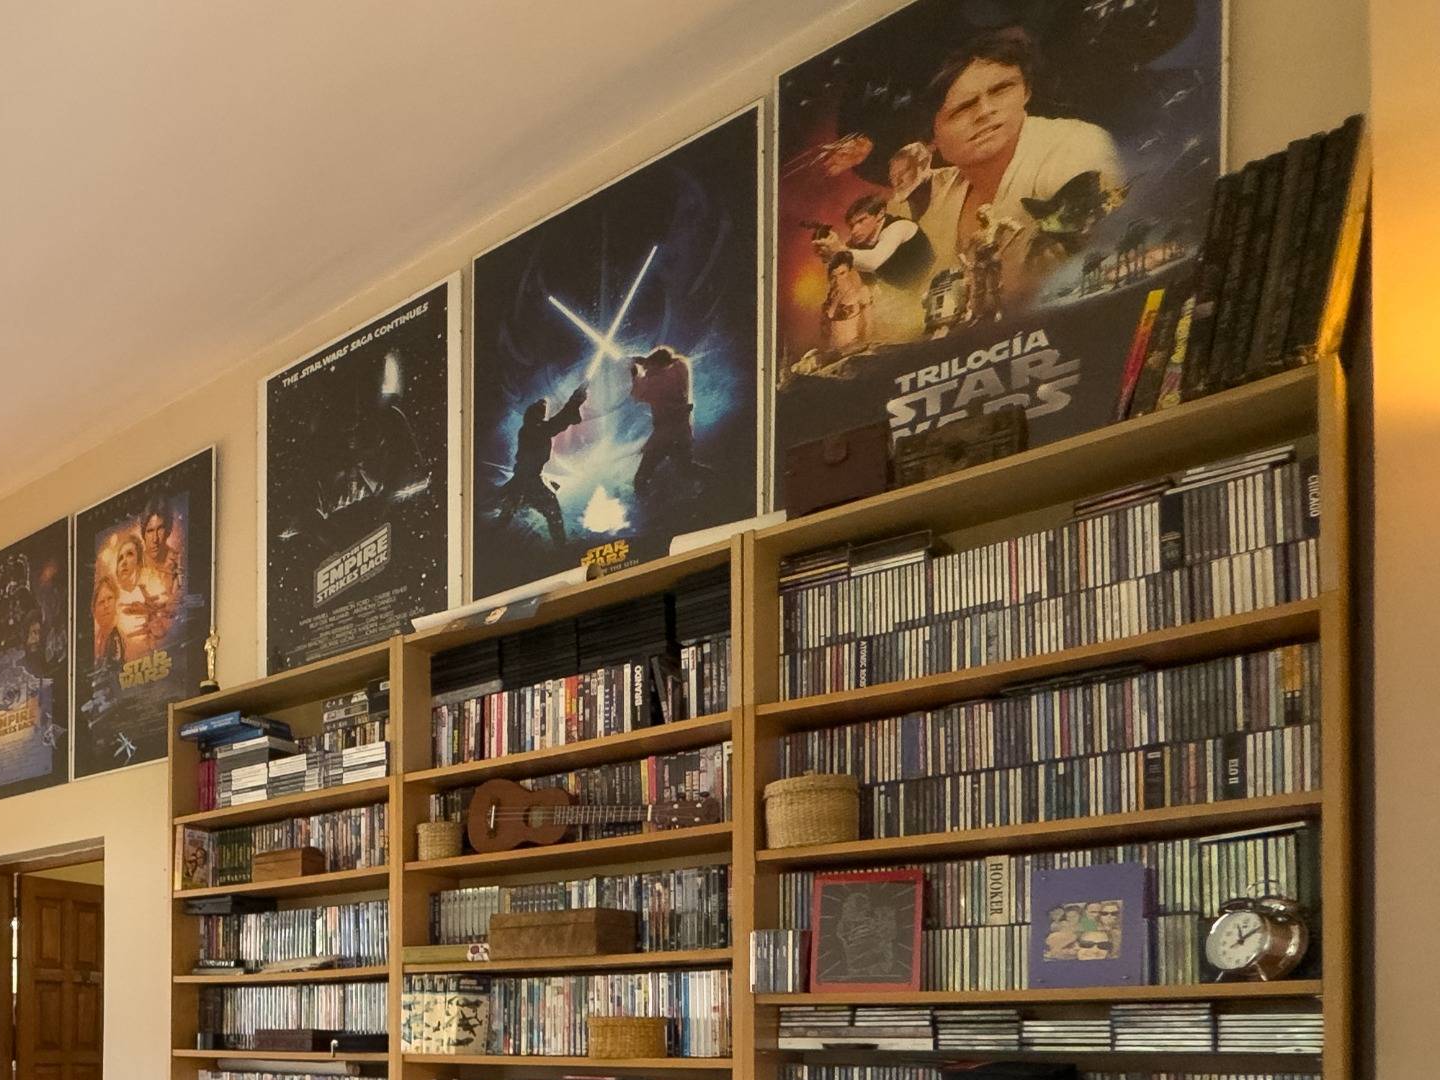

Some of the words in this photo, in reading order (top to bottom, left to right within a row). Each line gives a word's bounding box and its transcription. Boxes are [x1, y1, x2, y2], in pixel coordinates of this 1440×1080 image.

[282, 374, 299, 388] THE
[300, 361, 322, 379] STAR
[322, 345, 349, 366] WARS
[350, 333, 373, 351] SAGA
[374, 302, 429, 338] CONTINUES
[894, 329, 1051, 395] TRILOGÍA
[886, 349, 1081, 429] STAR
[316, 569, 359, 603] STRIKES
[360, 550, 388, 576] BACK
[317, 527, 388, 594] EMPIRE
[581, 539, 629, 561] STAR
[119, 667, 169, 690] WARS
[123, 649, 172, 673] STAR
[990, 863, 1003, 916] HOOKER
